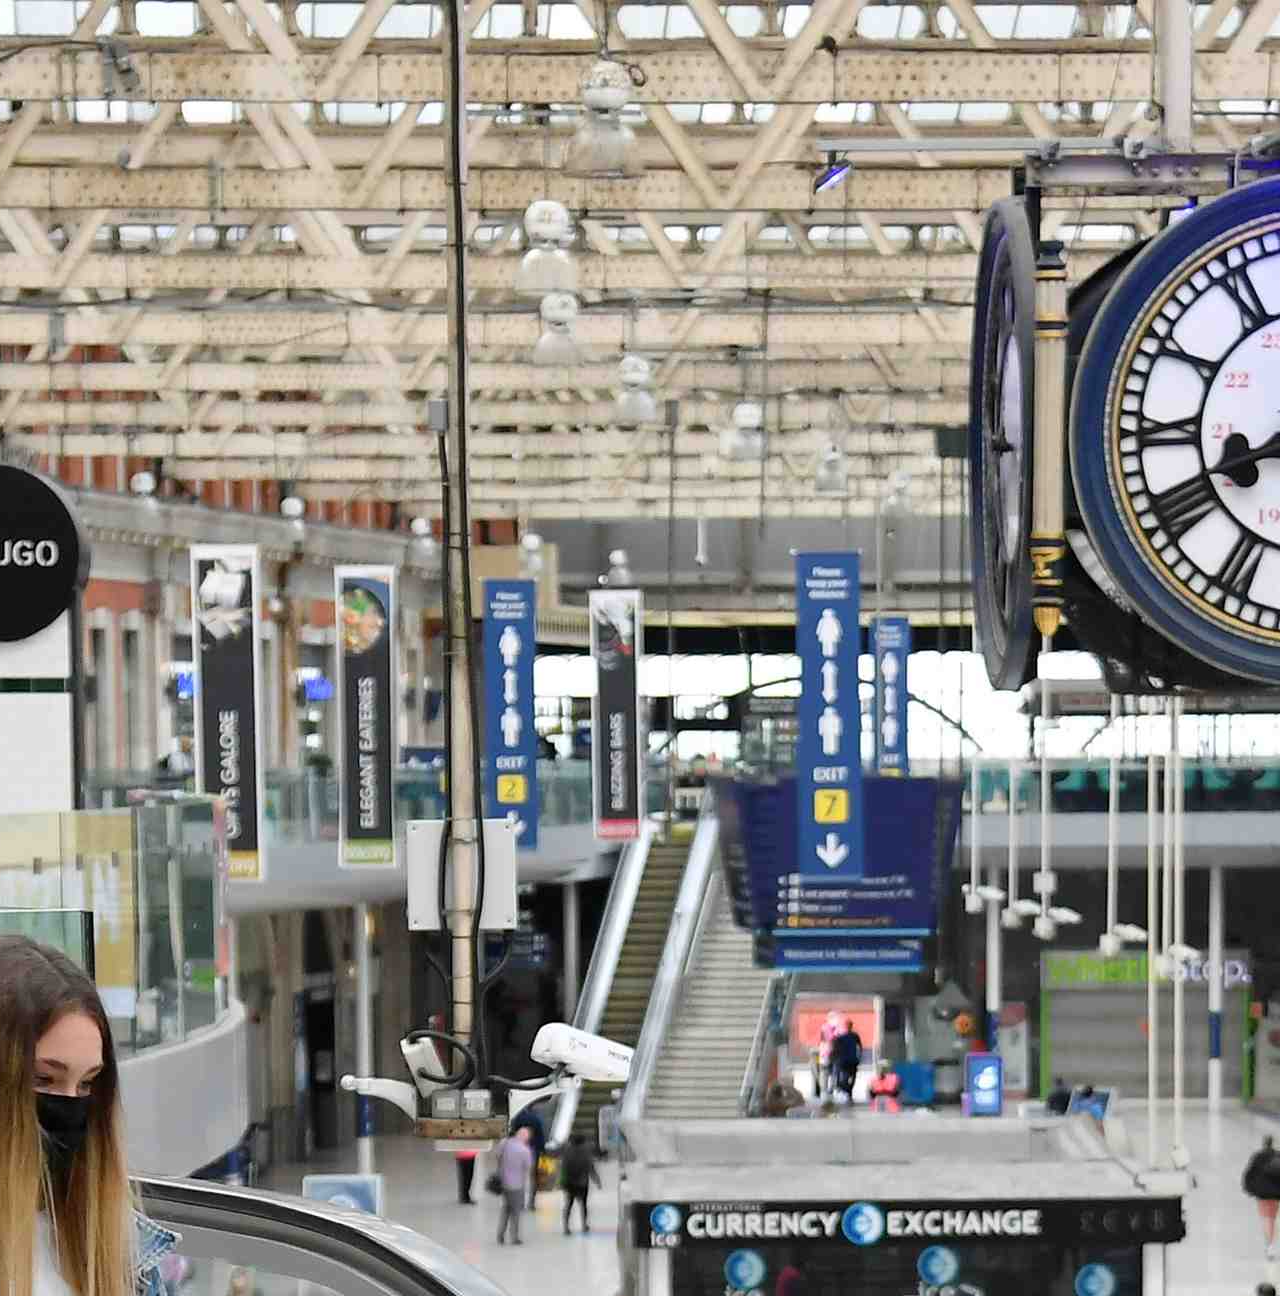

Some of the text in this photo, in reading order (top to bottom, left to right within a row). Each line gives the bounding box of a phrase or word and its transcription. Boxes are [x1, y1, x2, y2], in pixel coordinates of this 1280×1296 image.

[1224, 373, 1249, 388] 22
[1258, 509, 1280, 525] 19
[609, 712, 625, 748] BARS
[218, 710, 241, 785] GALORE
[358, 676, 379, 830] ELEGANT EATERIES
[496, 755, 524, 769] EXIT
[610, 752, 626, 811] BUZZING
[813, 766, 848, 783] EXIT
[504, 779, 517, 798] 2
[823, 794, 838, 817] 7
[686, 1209, 1043, 1239] CURRENCY EXCHANGE
[650, 1231, 680, 1247] ice
